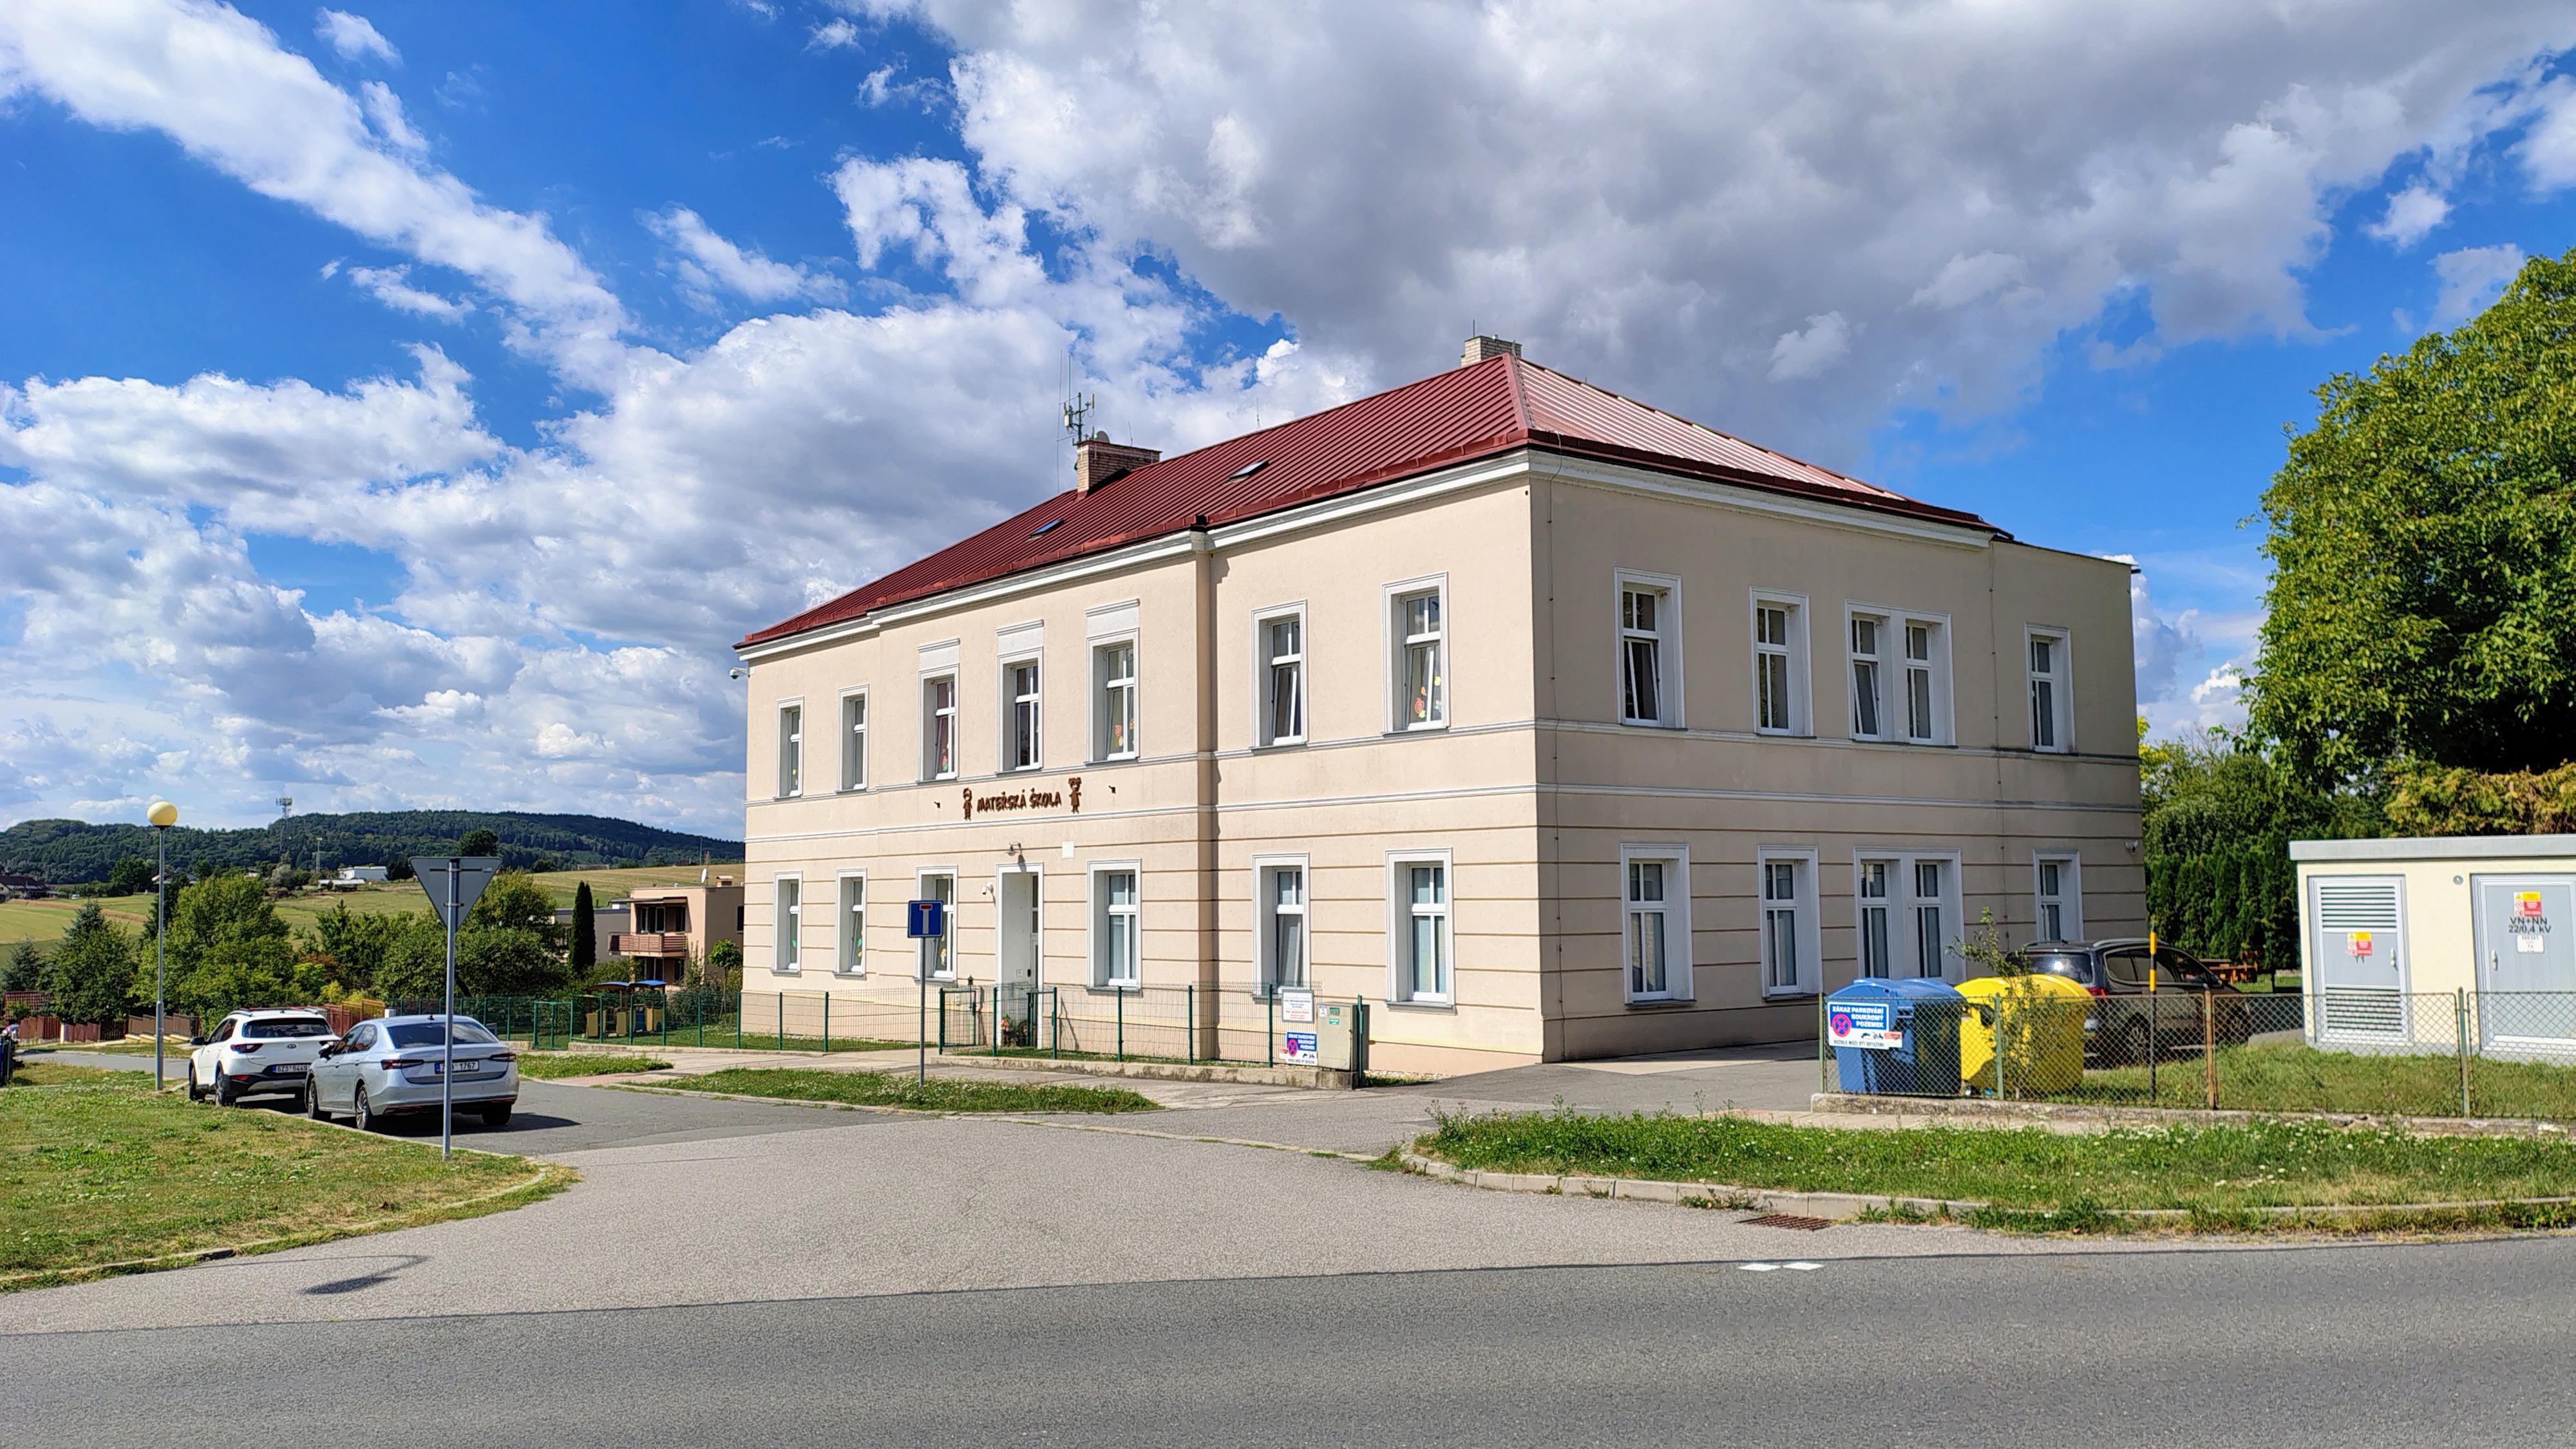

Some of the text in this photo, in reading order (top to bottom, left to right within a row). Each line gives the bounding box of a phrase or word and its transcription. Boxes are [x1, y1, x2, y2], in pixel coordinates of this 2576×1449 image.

[977, 788, 1061, 813] MATEŘSKÁ ŠKOLA
[2510, 916, 2547, 925] VN+NN
